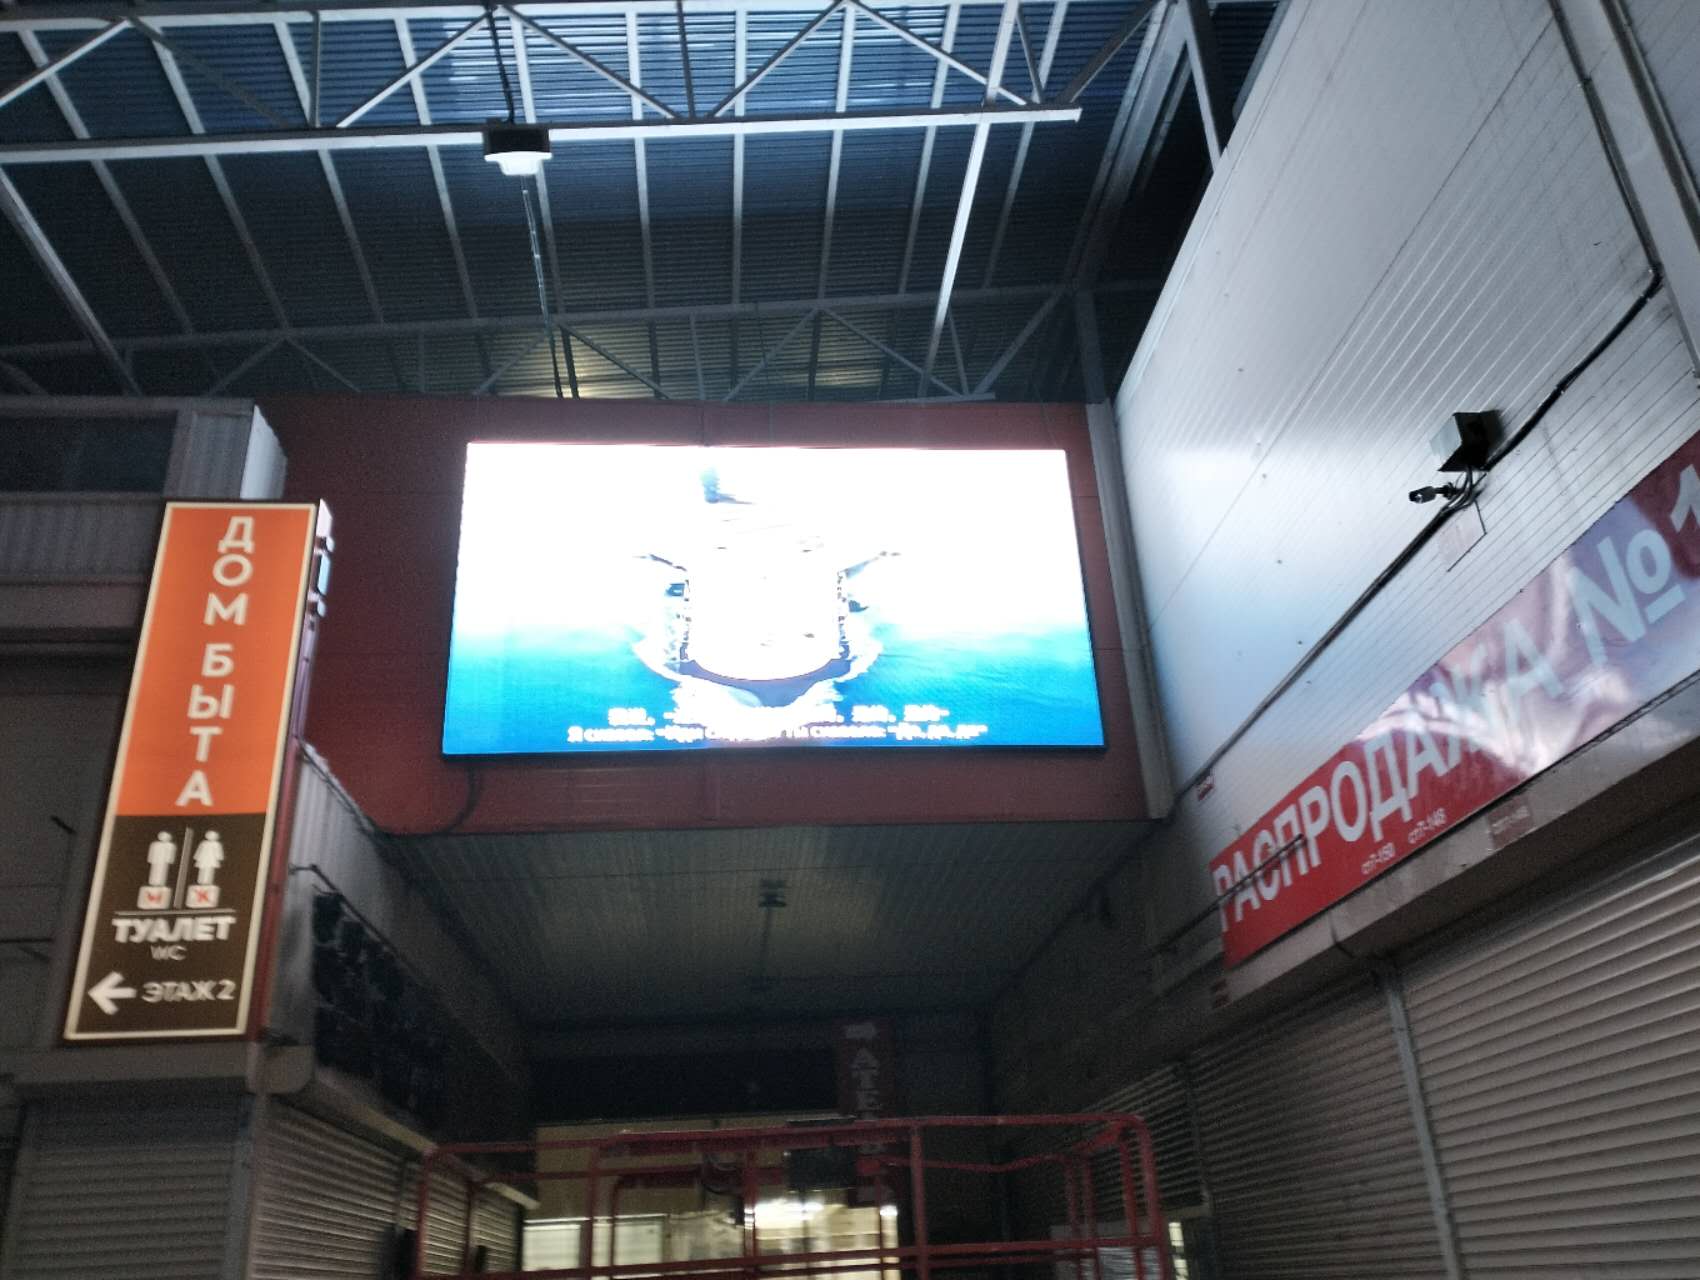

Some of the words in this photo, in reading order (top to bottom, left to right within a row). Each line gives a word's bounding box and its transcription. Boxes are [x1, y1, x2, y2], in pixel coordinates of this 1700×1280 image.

[203, 516, 255, 626] ДОМ
[175, 643, 235, 807] БЫТА
[111, 916, 237, 943] ТУАЛЕТ
[150, 945, 188, 961] WC
[141, 980, 217, 1003] ЭТАЖ
[215, 979, 237, 1001] 2
